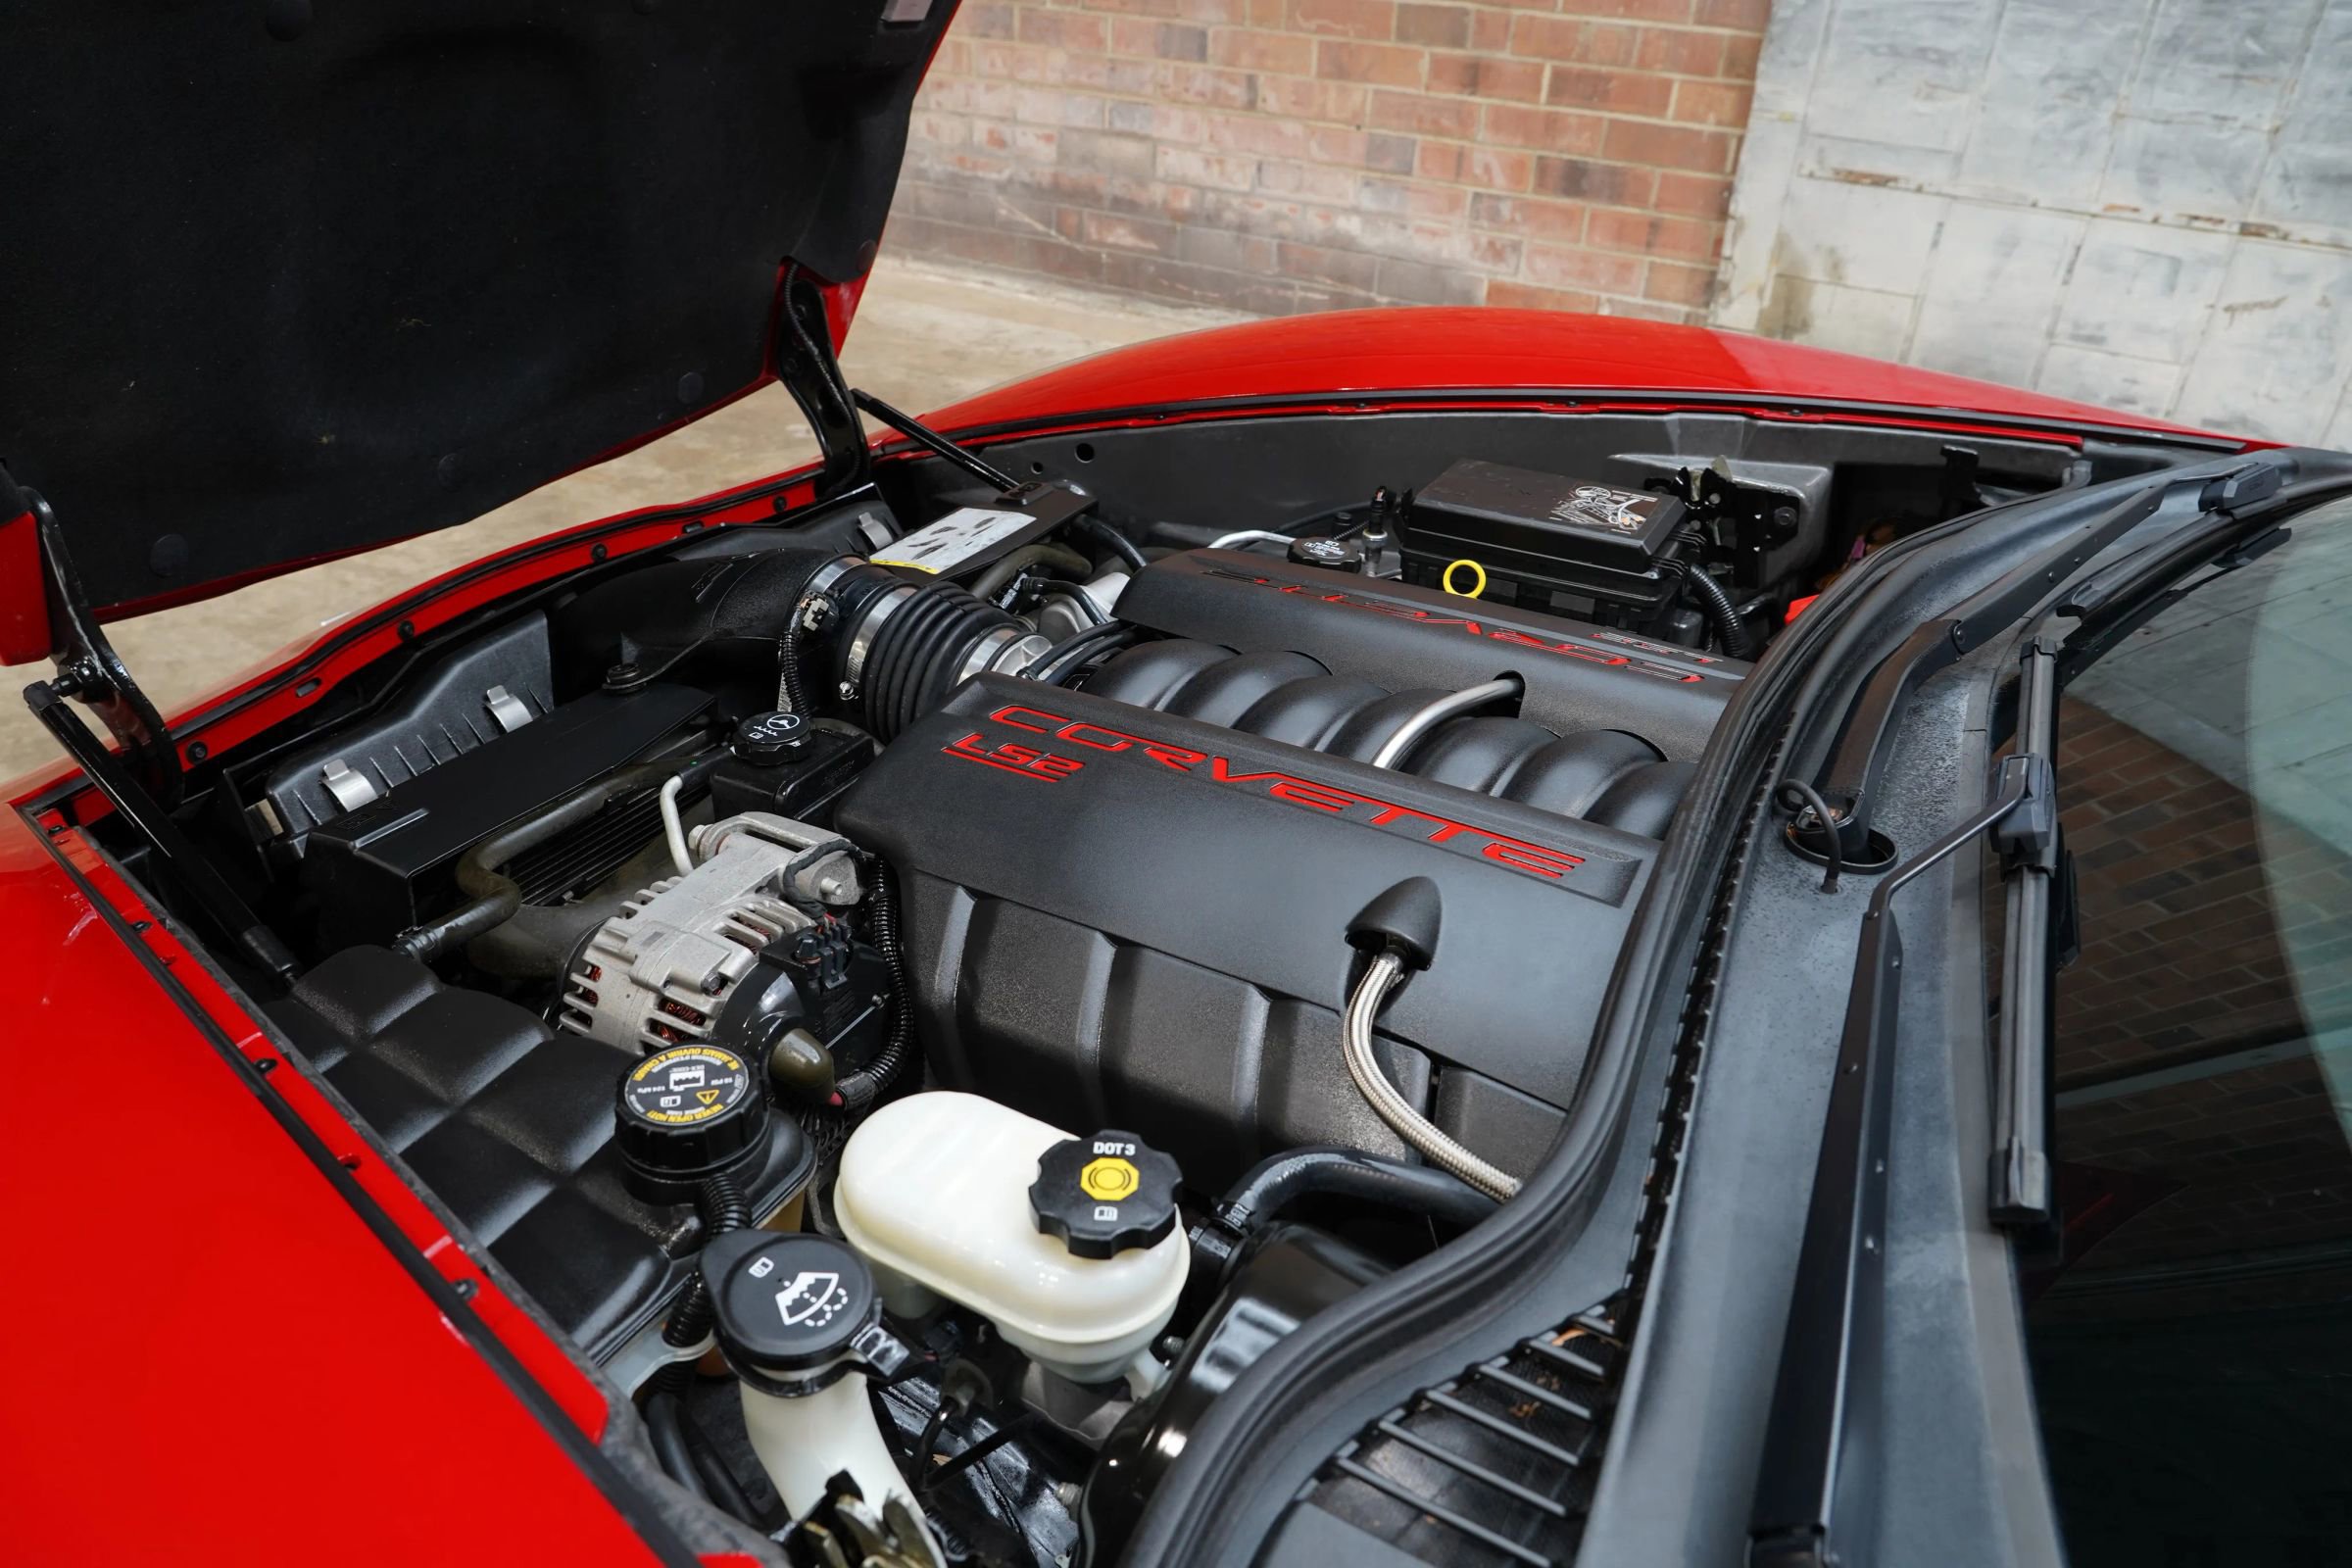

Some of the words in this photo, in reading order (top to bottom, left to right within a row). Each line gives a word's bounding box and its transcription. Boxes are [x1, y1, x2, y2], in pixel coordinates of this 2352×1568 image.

[951, 732, 1086, 780] LS2
[987, 704, 1586, 879] CORVETTE
[668, 1114, 694, 1123] OPEN
[695, 1103, 724, 1120] NEVER
[1093, 1142, 1124, 1155] DOT
[1124, 1143, 1136, 1155] 3
